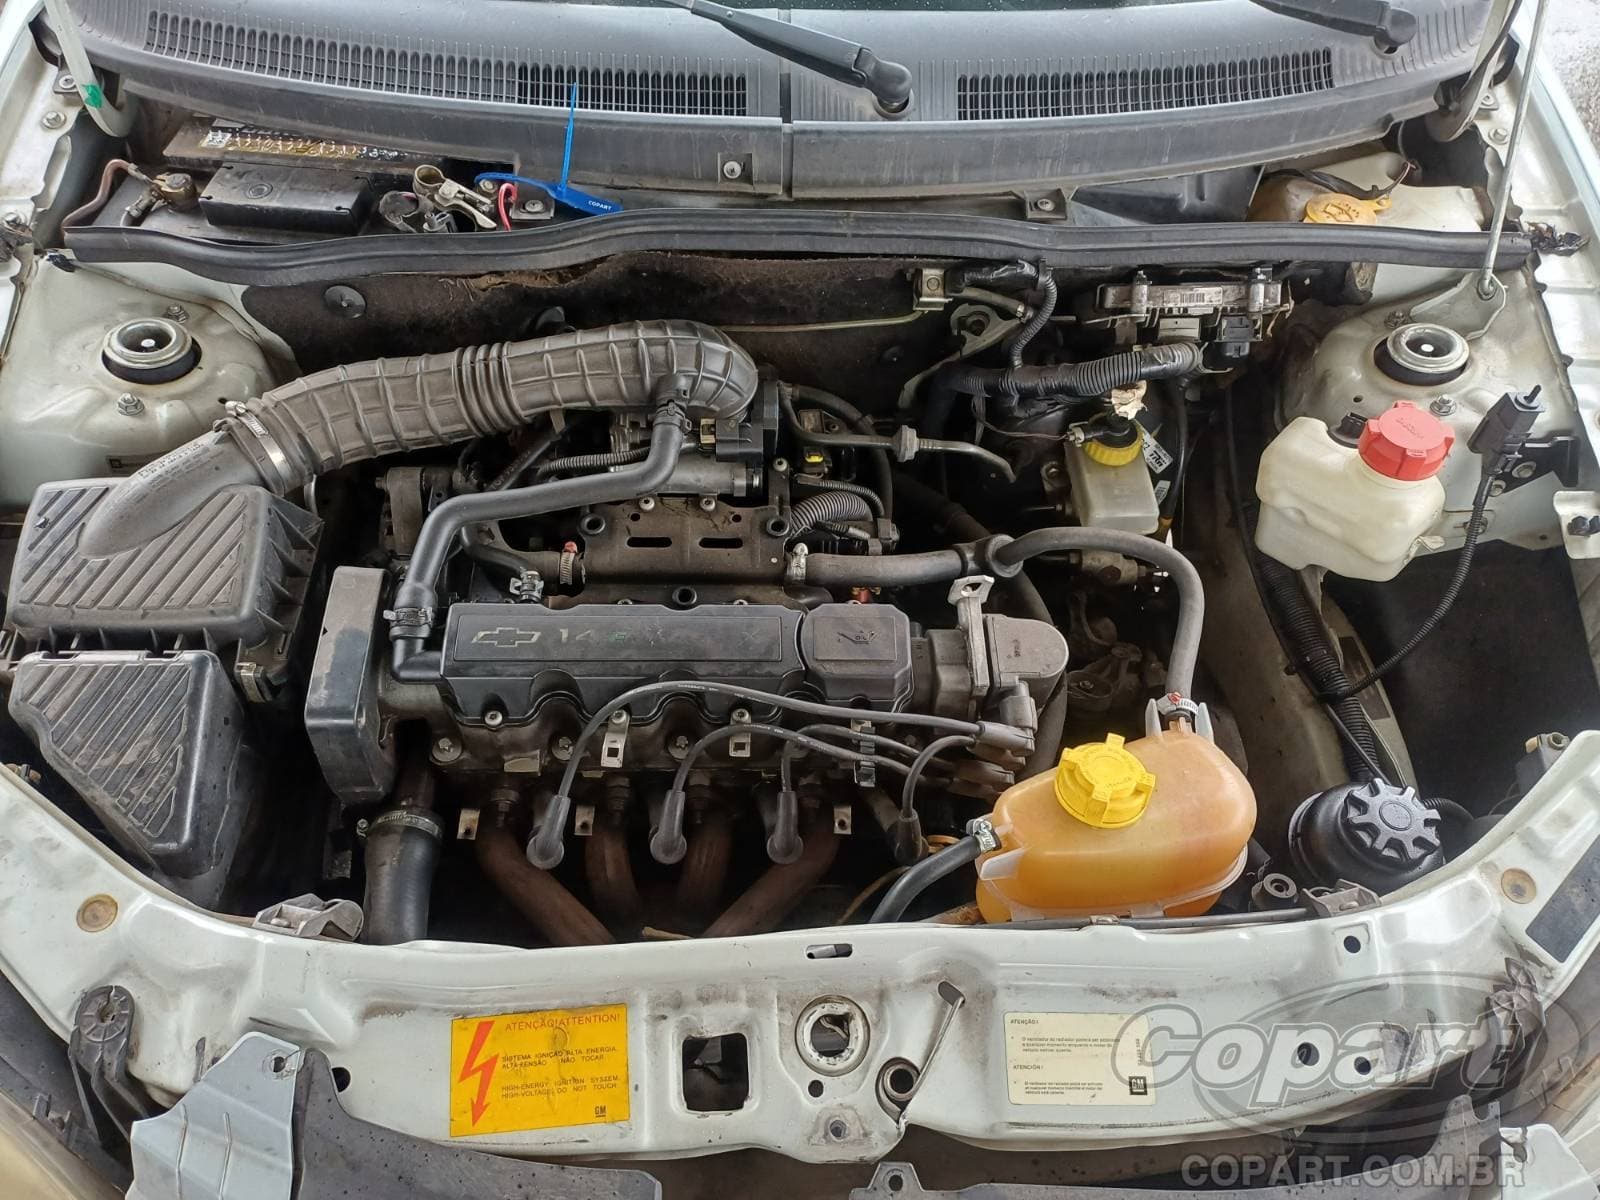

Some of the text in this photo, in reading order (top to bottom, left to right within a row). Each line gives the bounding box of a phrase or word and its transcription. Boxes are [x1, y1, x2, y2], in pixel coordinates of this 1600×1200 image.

[588, 200, 612, 211] COPART
[560, 1056, 576, 1064] NÃO
[1131, 1078, 1145, 1092] GM
[594, 1105, 607, 1116] GM
